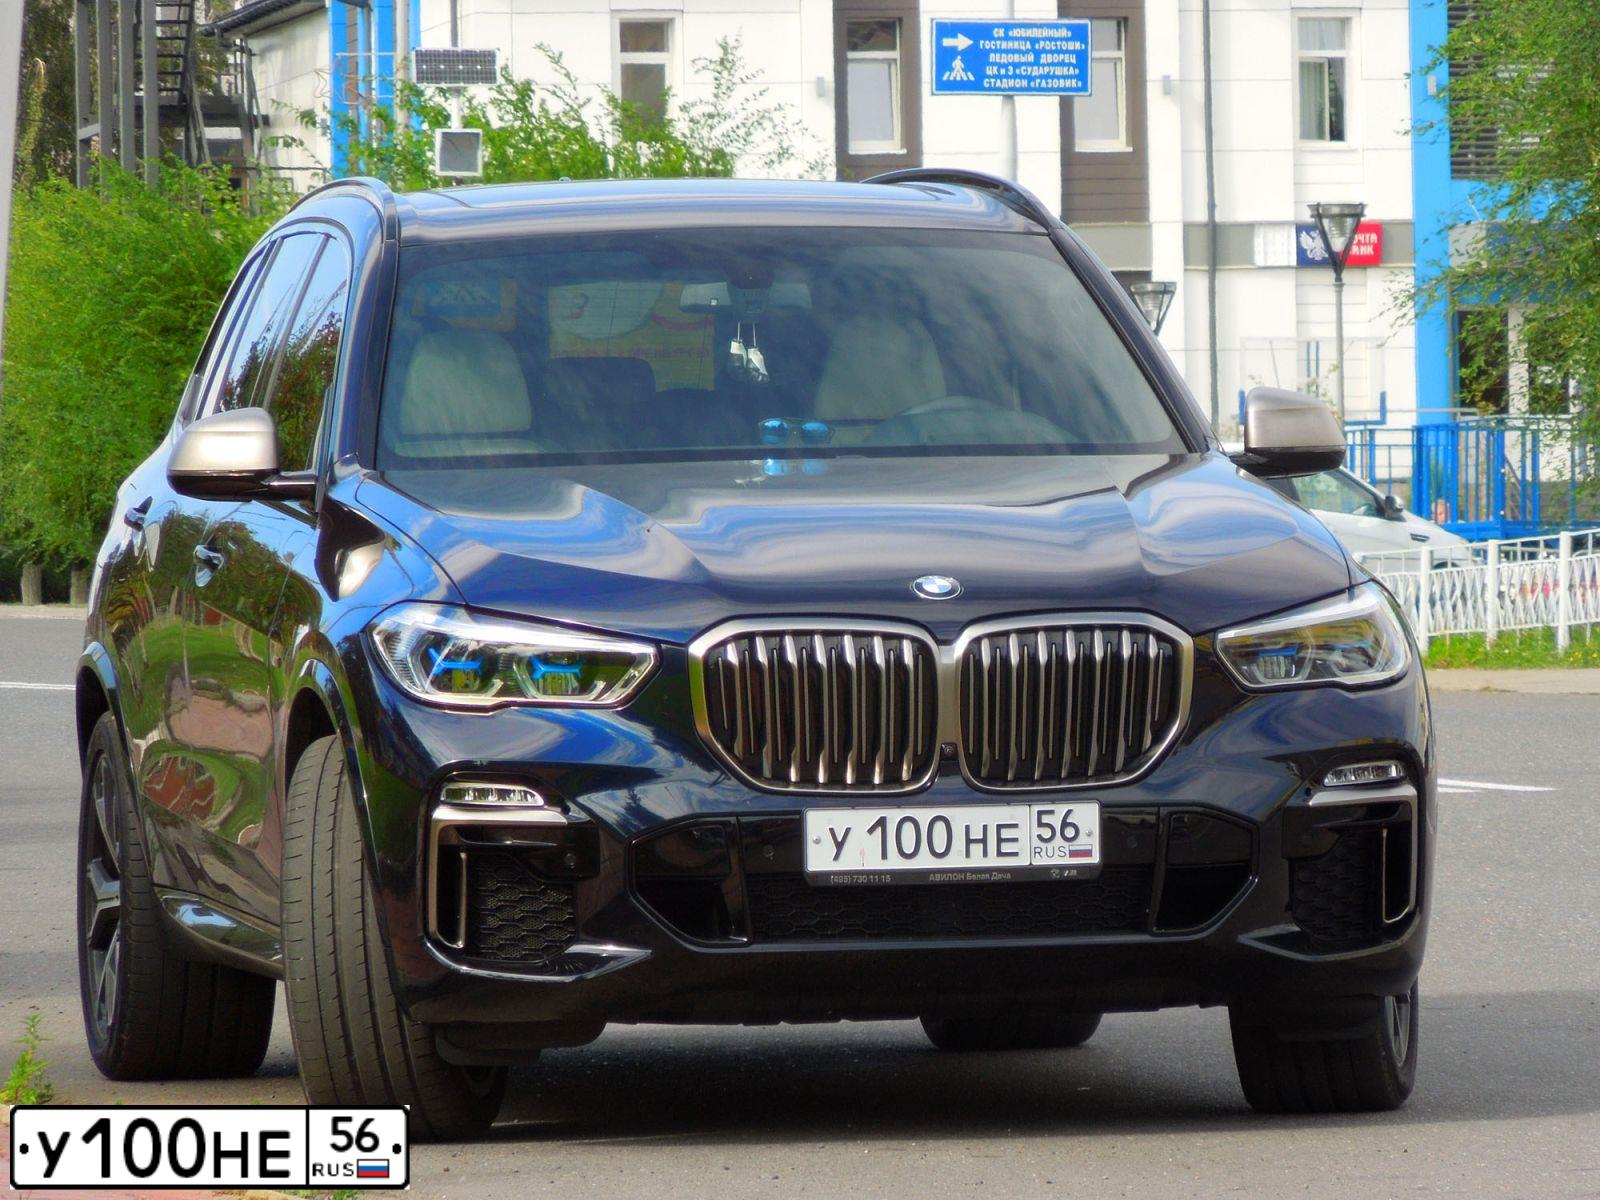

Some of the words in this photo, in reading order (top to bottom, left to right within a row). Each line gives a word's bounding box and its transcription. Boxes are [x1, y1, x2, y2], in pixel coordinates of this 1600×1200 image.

[993, 28, 1004, 38] СК
[980, 40, 1031, 50] ГОСТИНИЦА
[1036, 40, 1085, 50] «РОСТОШИ»
[990, 52, 1034, 64] ЛЕДОВЫЙ
[1041, 54, 1076, 64] ДВОРЕЦ
[986, 66, 998, 76] ЦК
[984, 78, 1027, 88] СТАДИОН
[1352, 245, 1374, 255] АНК
[1036, 809, 1080, 843] 56
[1034, 846, 1067, 859] RUS
